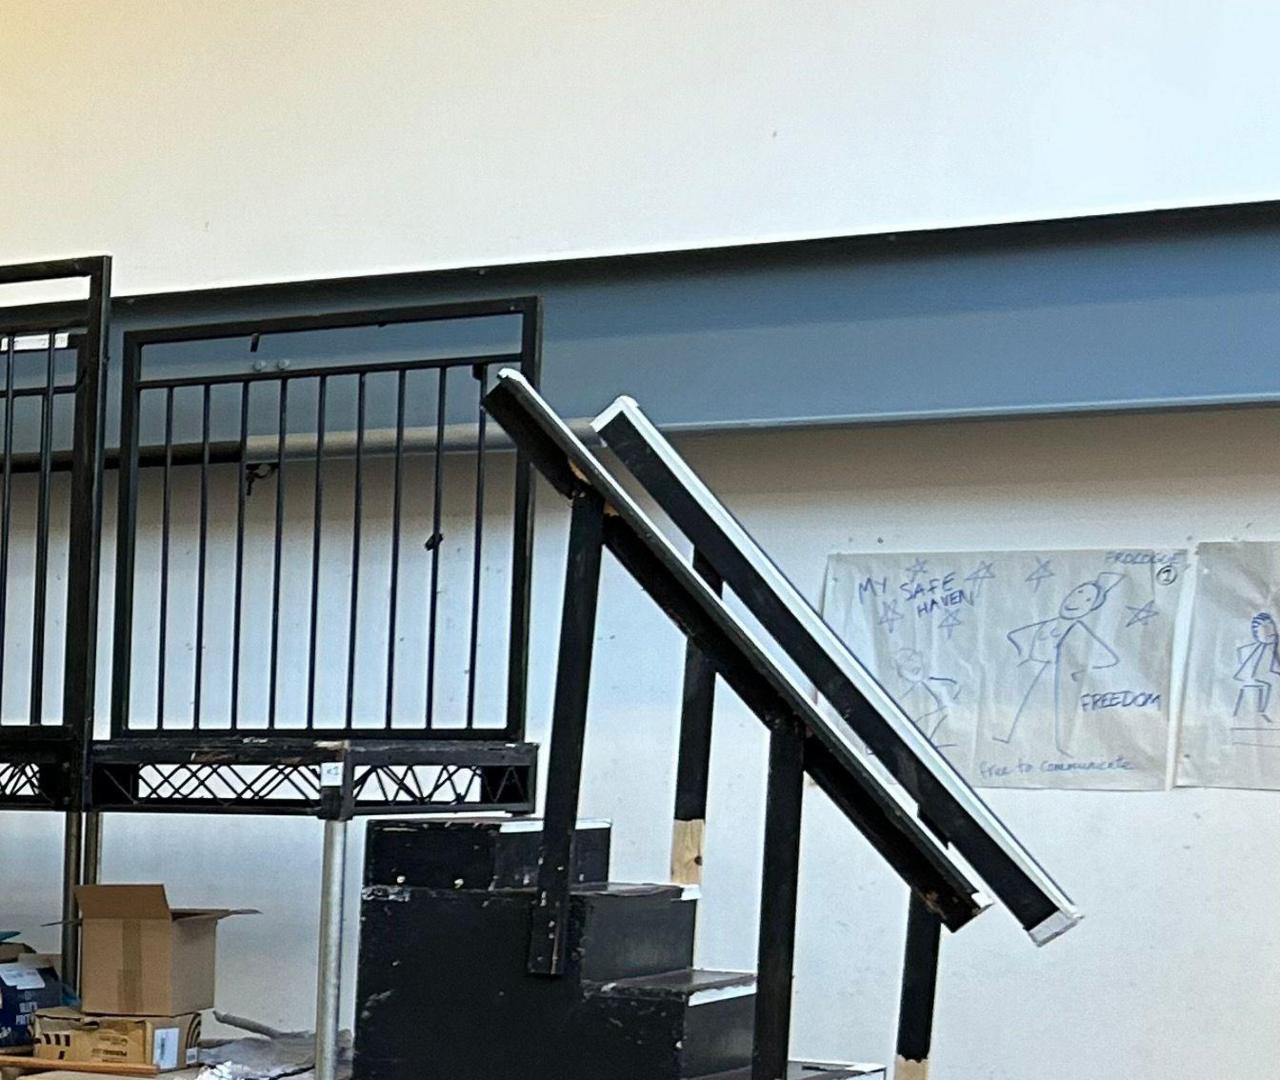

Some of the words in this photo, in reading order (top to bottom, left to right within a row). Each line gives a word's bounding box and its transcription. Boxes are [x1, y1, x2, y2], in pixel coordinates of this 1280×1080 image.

[859, 577, 887, 604] MY
[900, 571, 956, 601] SAFE
[916, 589, 975, 618] HAVEN
[1080, 690, 1161, 712] FREEDOM
[1016, 757, 1034, 774] to
